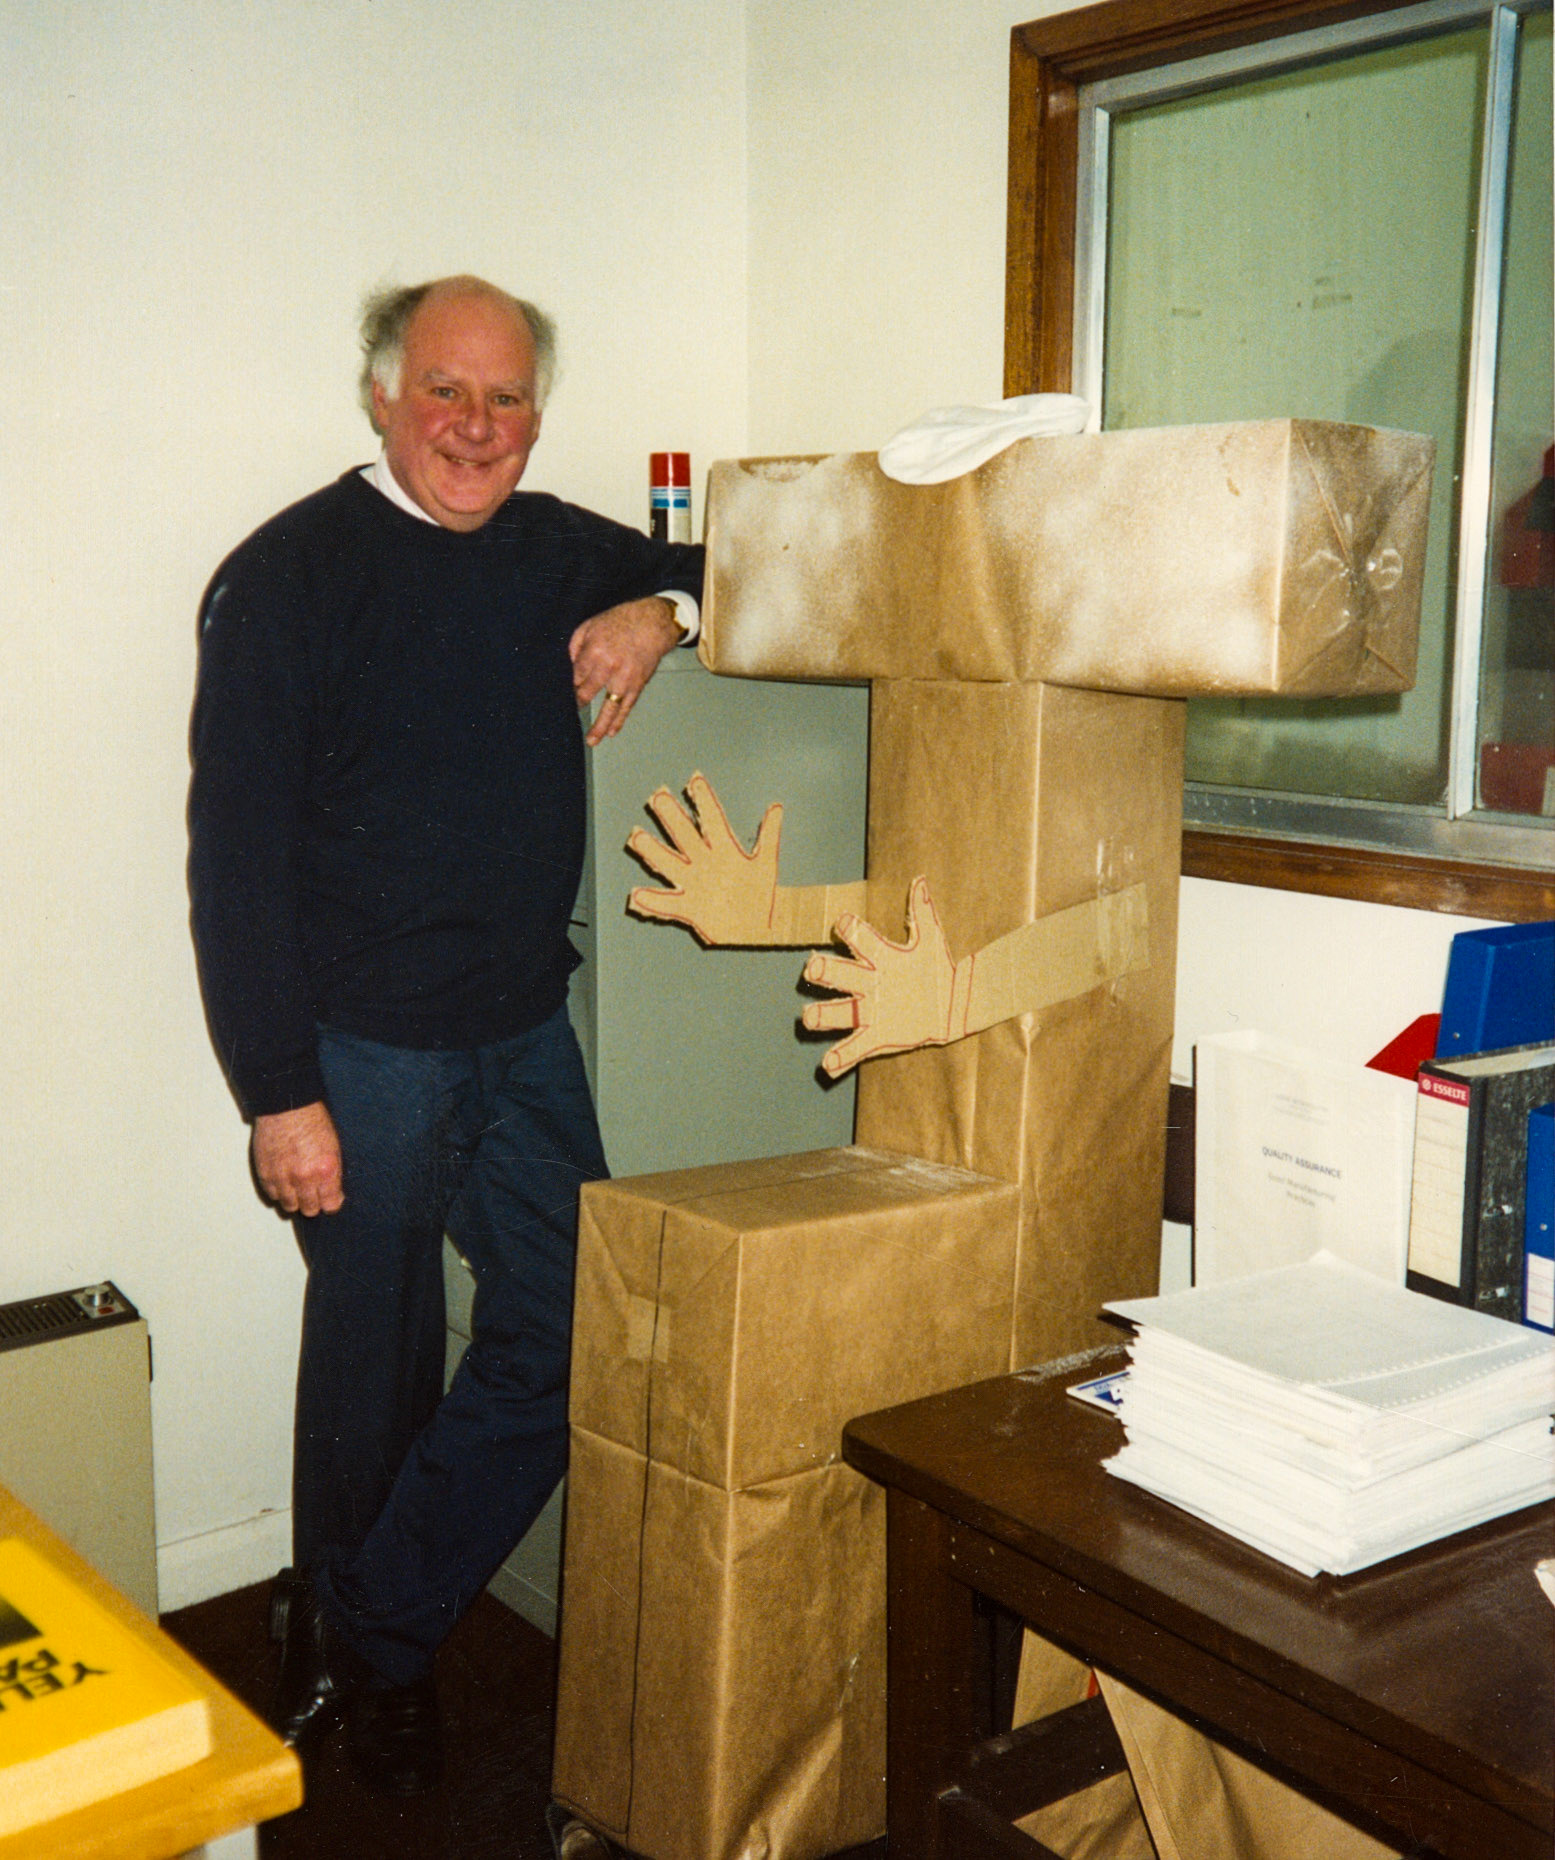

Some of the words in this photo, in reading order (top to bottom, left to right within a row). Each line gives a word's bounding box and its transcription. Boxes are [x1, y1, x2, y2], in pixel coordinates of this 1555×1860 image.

[1433, 1083, 1466, 1101] ESSELTE
[1262, 1146, 1293, 1162] QUALITY
[1295, 1156, 1342, 1179] ASSURANCE
[0, 1662, 107, 1711] YEL
